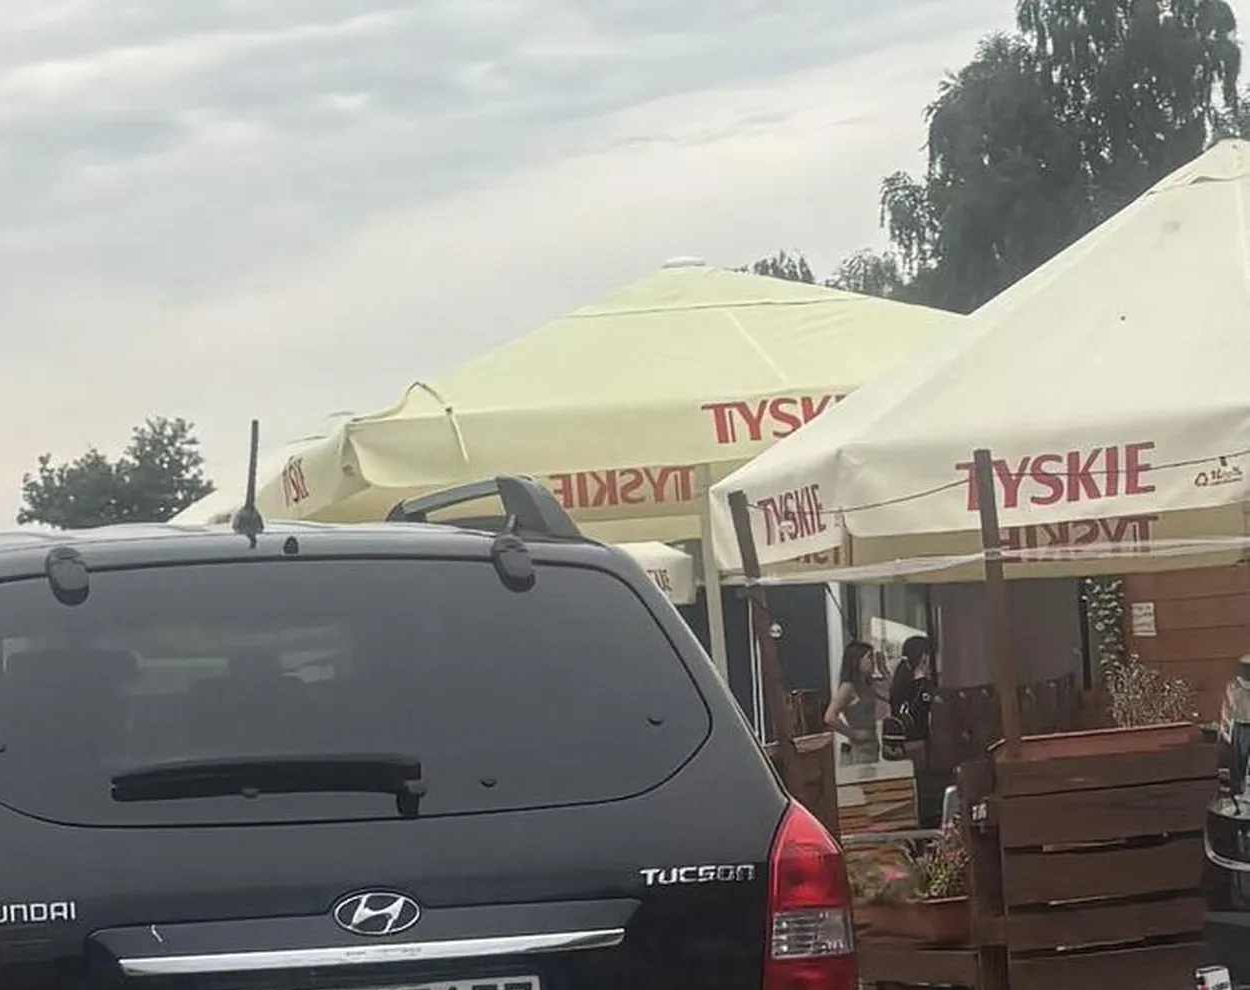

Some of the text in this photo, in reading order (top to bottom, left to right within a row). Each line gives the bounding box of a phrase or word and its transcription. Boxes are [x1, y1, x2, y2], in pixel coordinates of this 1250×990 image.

[702, 394, 847, 444] TYSK
[955, 441, 1156, 511] TYSKIE
[756, 484, 826, 546] TYSKIE
[639, 865, 755, 886] TUCSON
